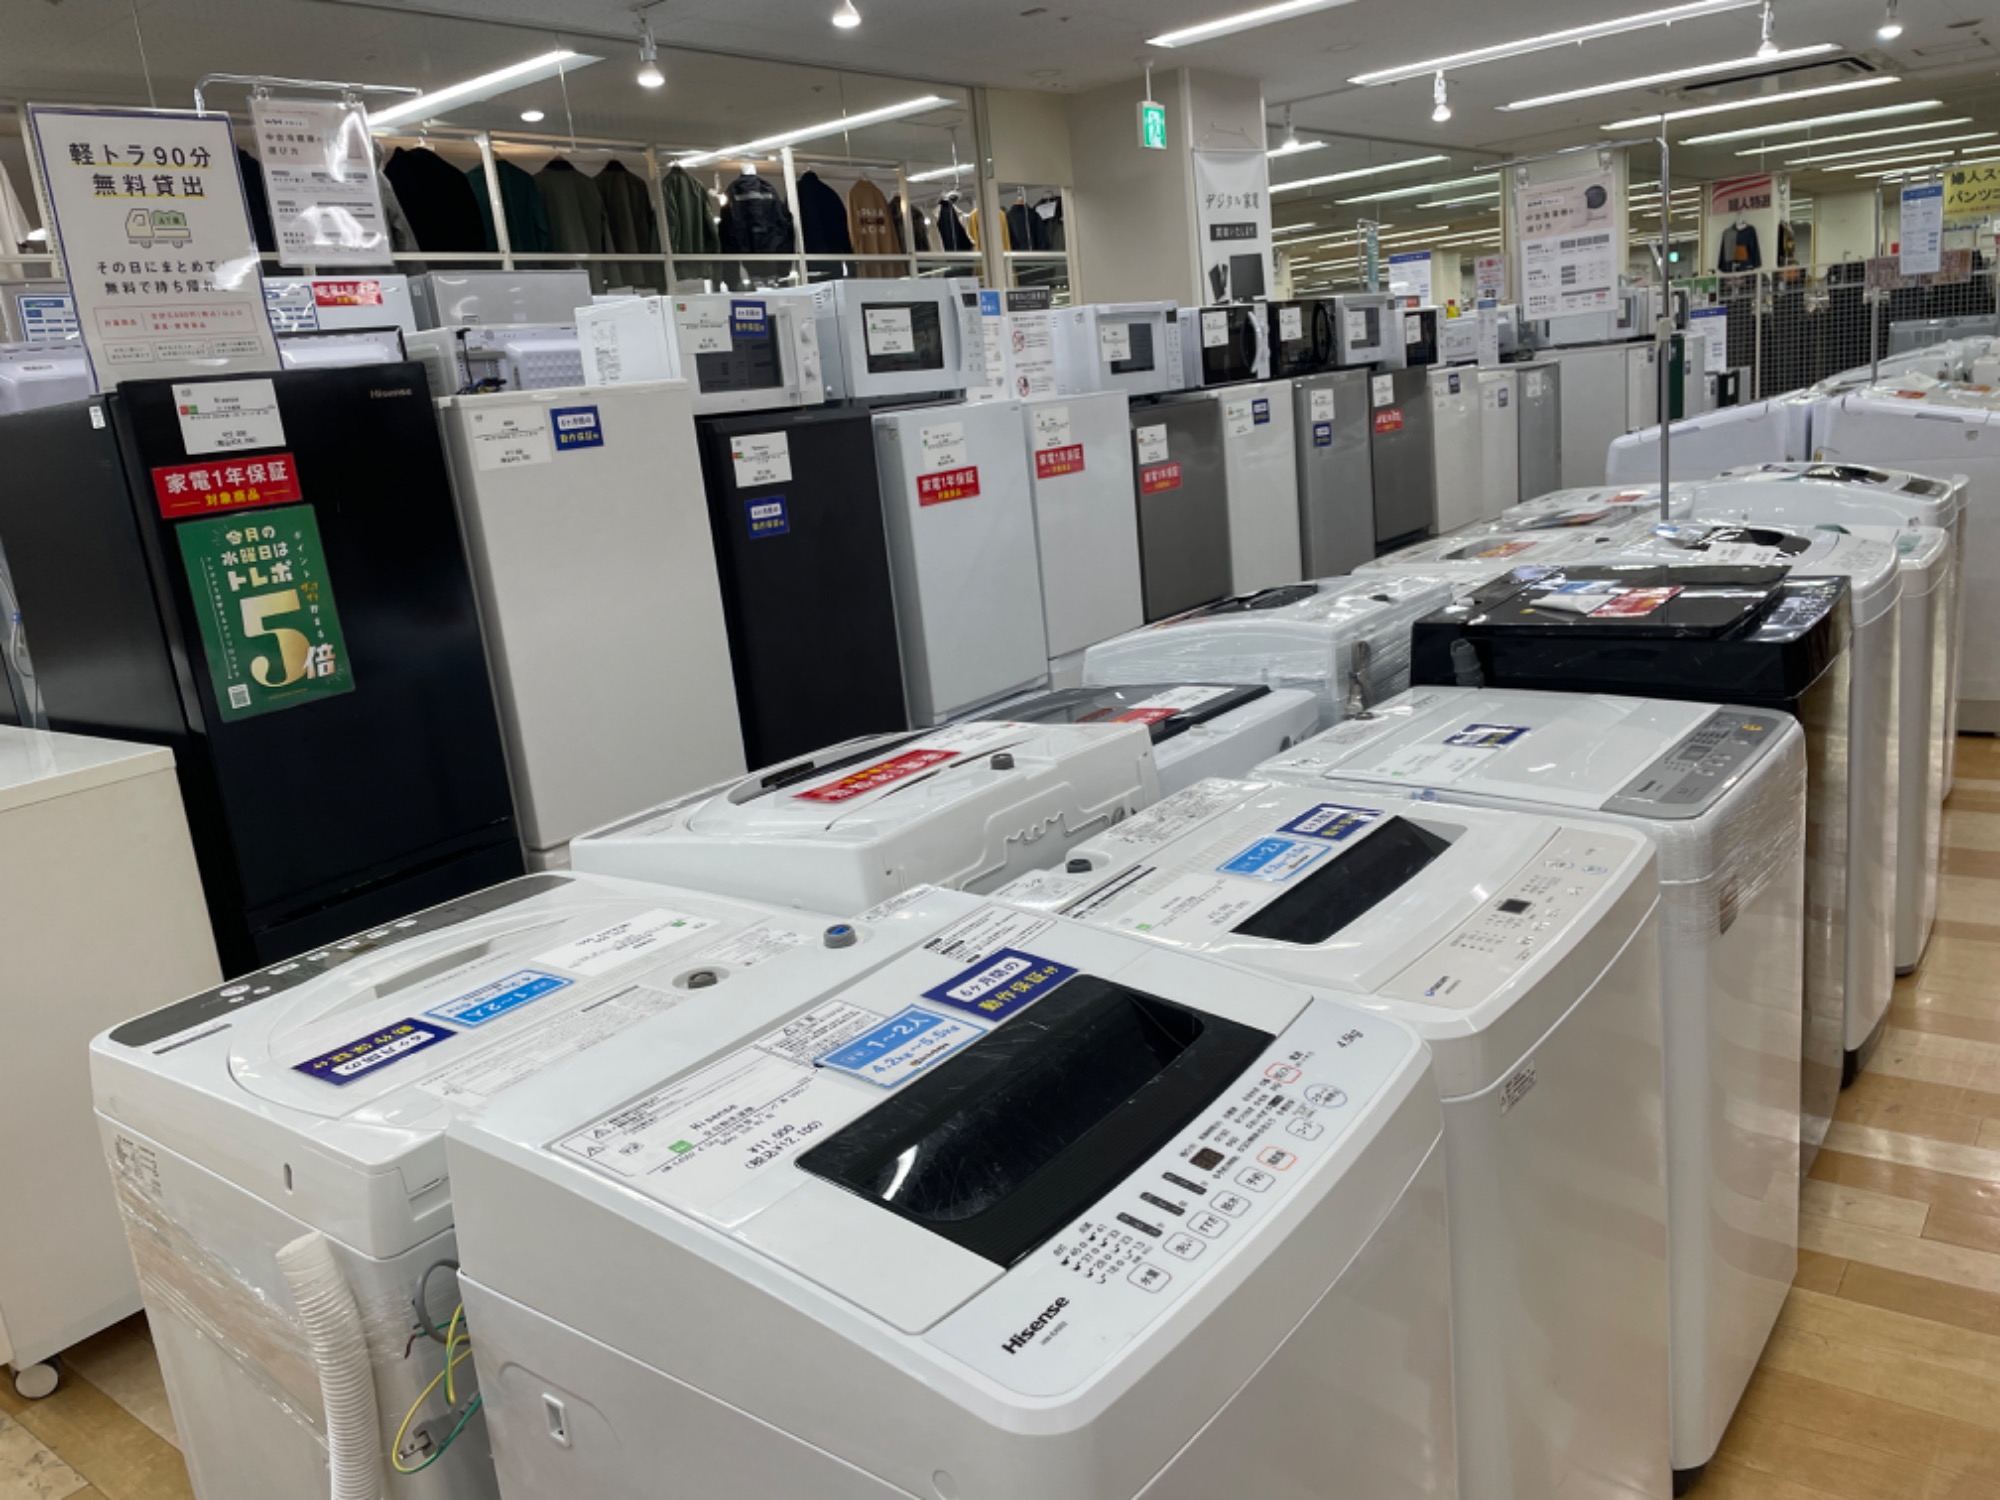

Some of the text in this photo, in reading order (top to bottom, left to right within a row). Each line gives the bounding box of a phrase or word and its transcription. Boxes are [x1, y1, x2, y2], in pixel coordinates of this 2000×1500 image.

[69, 143, 211, 168] 軽トラ90分
[93, 172, 205, 197] 無料貸出
[165, 460, 289, 494] 家電1年保証
[205, 488, 260, 506] 対象商品
[226, 525, 276, 545] 今月の
[221, 541, 288, 567] 水曜日は
[227, 559, 294, 592] トレポ
[240, 589, 311, 687] 5
[303, 643, 335, 679] 倍
[960, 961, 1020, 998] 6ヶ月間の
[978, 965, 1060, 1012] 動作保証付
[1001, 1296, 1070, 1355] Hisense
